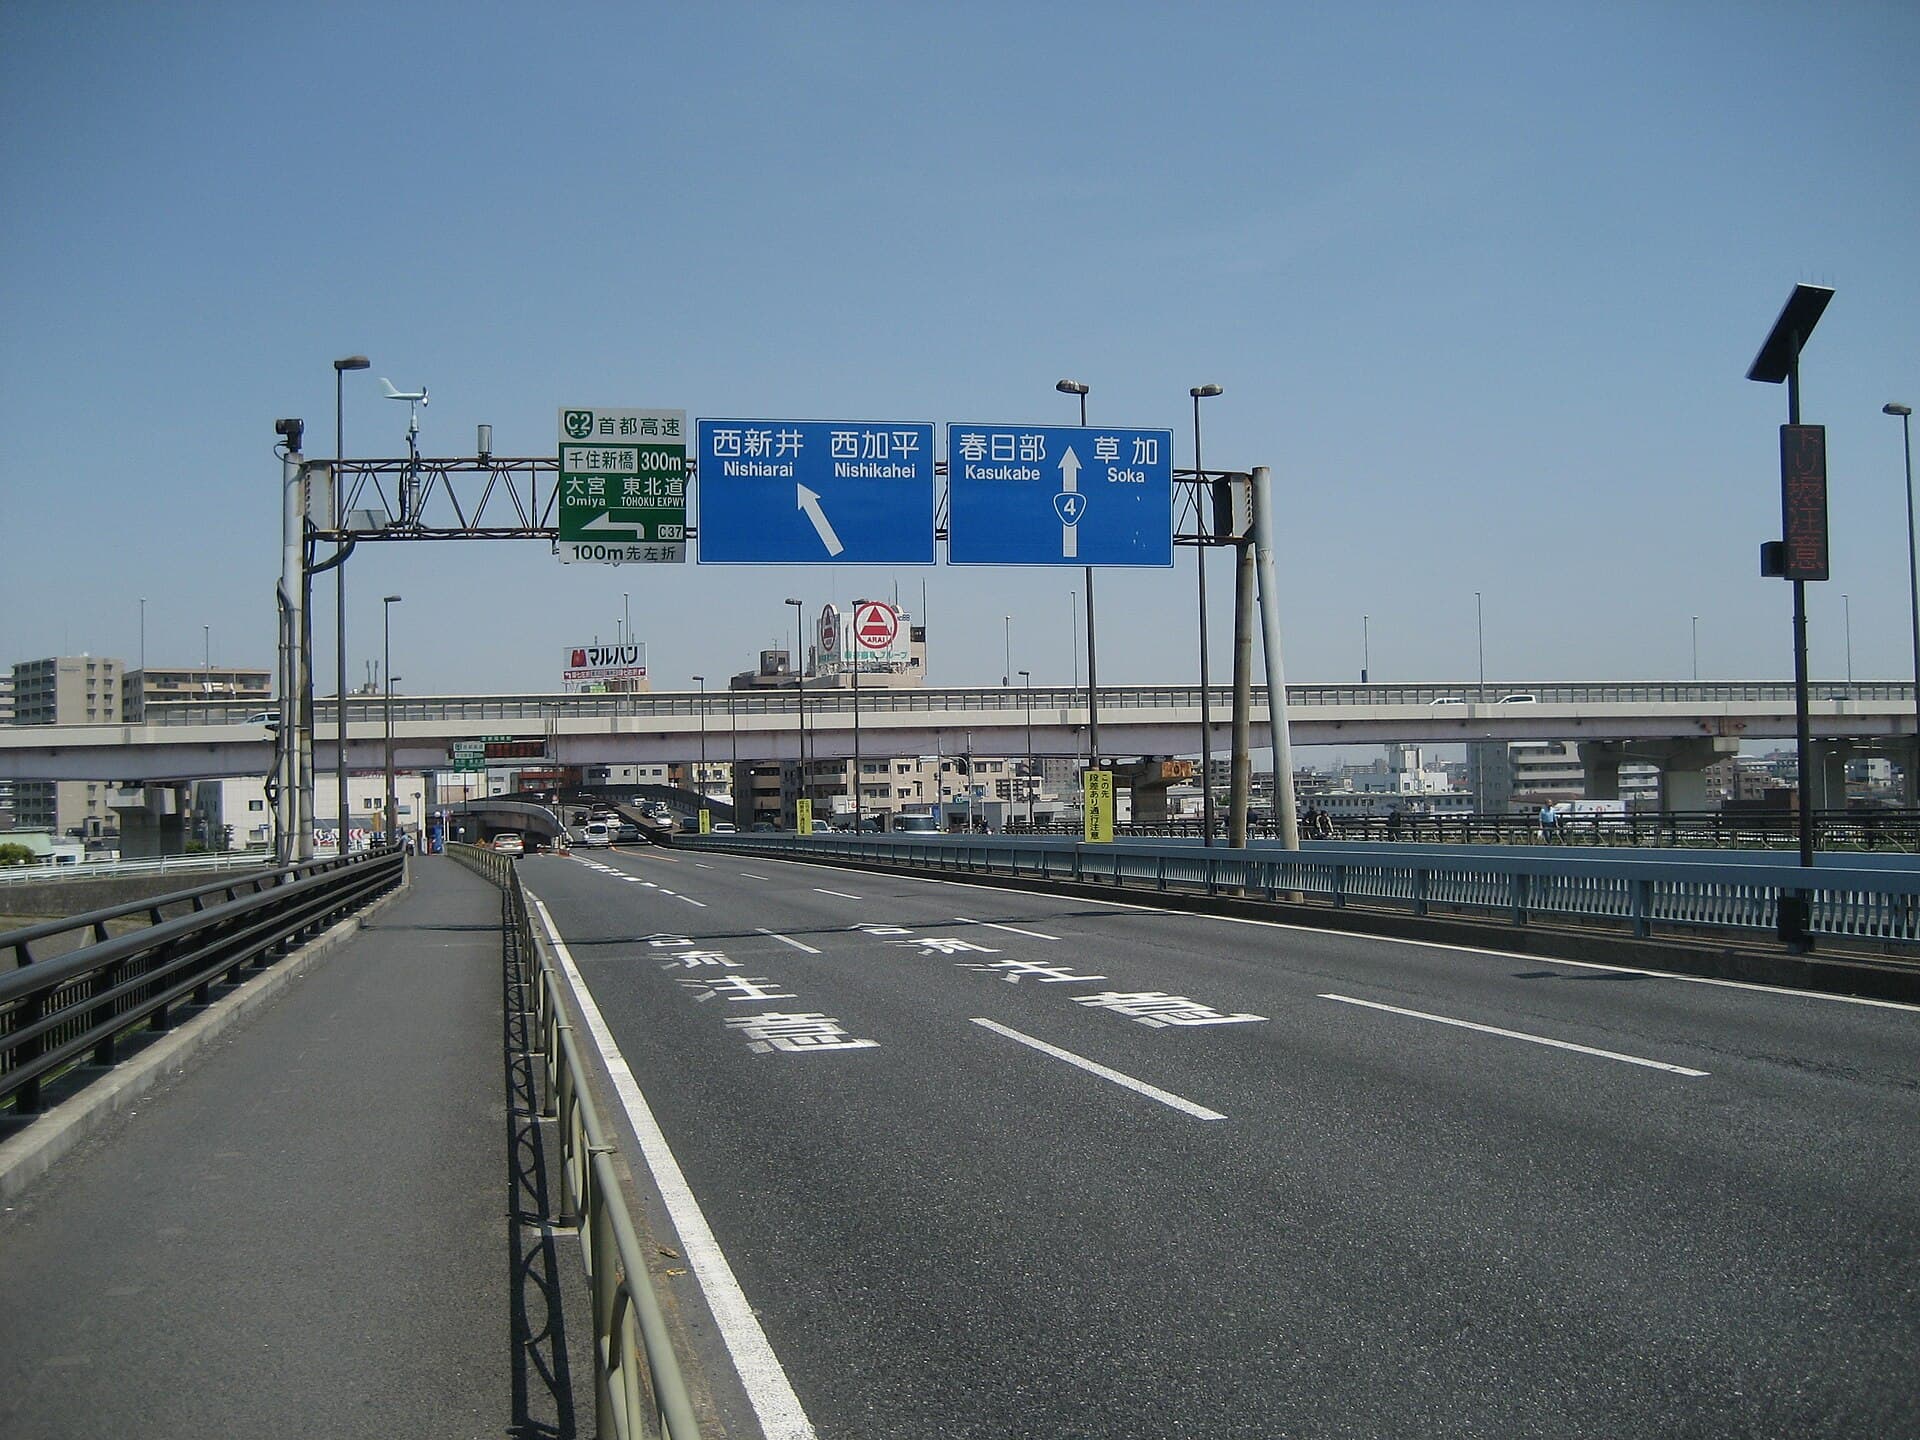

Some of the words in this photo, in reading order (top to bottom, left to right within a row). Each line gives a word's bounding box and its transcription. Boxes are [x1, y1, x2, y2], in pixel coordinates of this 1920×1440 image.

[566, 412, 591, 430] C2
[598, 417, 681, 436] 首都高速
[712, 428, 804, 458] 西新井
[830, 430, 920, 460] 西加平
[959, 433, 1046, 463] 春日部
[1093, 436, 1158, 465] 草加
[569, 450, 634, 470] 千住新橋
[641, 452, 681, 471] 300m
[724, 461, 793, 477] Nishiarai
[835, 462, 916, 479] Nishikahei
[965, 465, 1041, 481] Kasukabe
[1107, 467, 1145, 483] Soka
[566, 476, 606, 495] 大宮
[623, 477, 684, 496] 東北道
[566, 496, 606, 508] Omiya
[621, 496, 655, 507] TOHOKU
[657, 497, 685, 507] EXPWY
[1063, 497, 1077, 516] 4
[659, 526, 682, 538] C37
[588, 646, 638, 666] マルハン
[1101, 774, 1109, 798] この先
